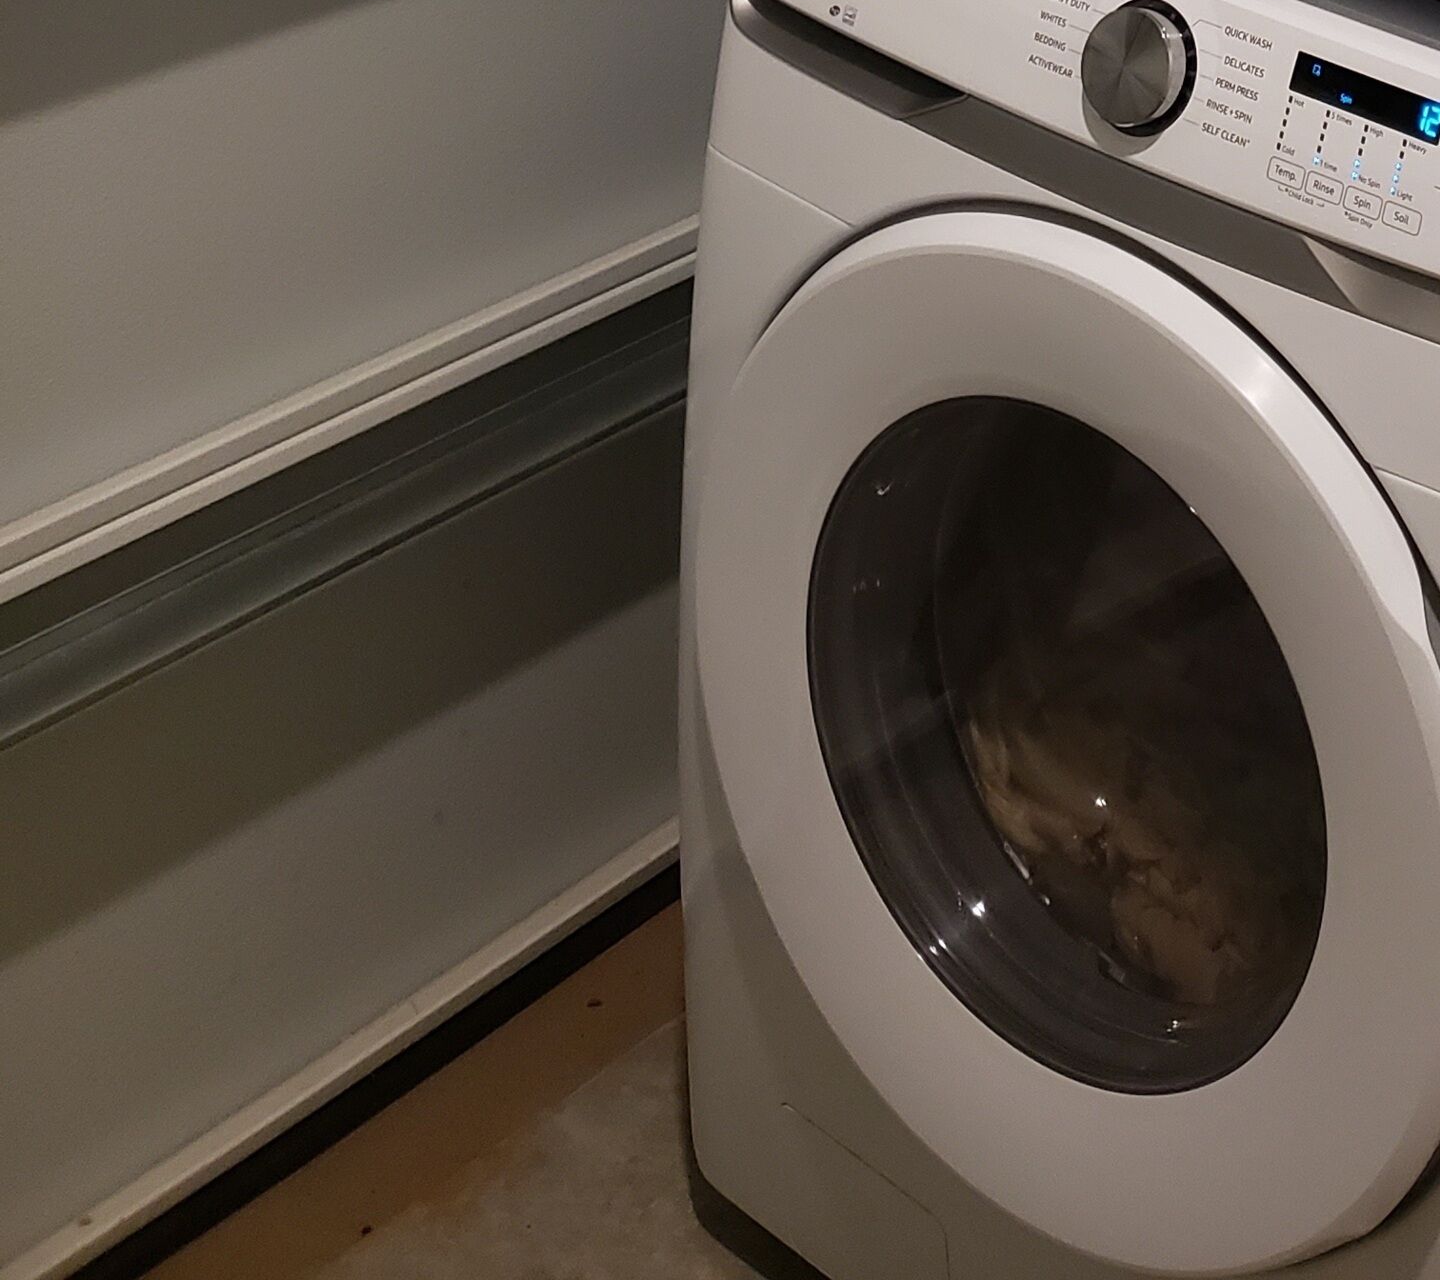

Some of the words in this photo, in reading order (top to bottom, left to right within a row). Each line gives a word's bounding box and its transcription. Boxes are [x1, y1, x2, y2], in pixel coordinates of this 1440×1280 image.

[1040, 11, 1067, 28] WHITES
[1034, 32, 1066, 52] BEDDING
[1224, 25, 1249, 44] QUICK
[1249, 34, 1273, 51] WASH
[1028, 54, 1073, 79] ACTIVEWEAR
[1224, 55, 1265, 78] DELICATES
[1215, 77, 1235, 93] PERM
[1236, 84, 1259, 102] PRESS
[1294, 98, 1305, 108] Hot
[1206, 98, 1229, 116] RINSE
[1234, 109, 1252, 124] SPIN
[1336, 113, 1352, 126] times
[1201, 122, 1221, 136] SELF
[1369, 127, 1384, 138] High
[1281, 145, 1295, 156] Cold
[1408, 140, 1427, 155] Heavy
[1275, 164, 1297, 182] Temp.
[1324, 161, 1338, 172] time
[1312, 179, 1335, 196] Rinse
[1367, 178, 1381, 189] Spin
[1288, 190, 1302, 200] Child
[1302, 195, 1314, 206] Lock
[1353, 195, 1372, 210] Spin
[1396, 190, 1413, 202] Light
[1393, 211, 1409, 225] Soil
